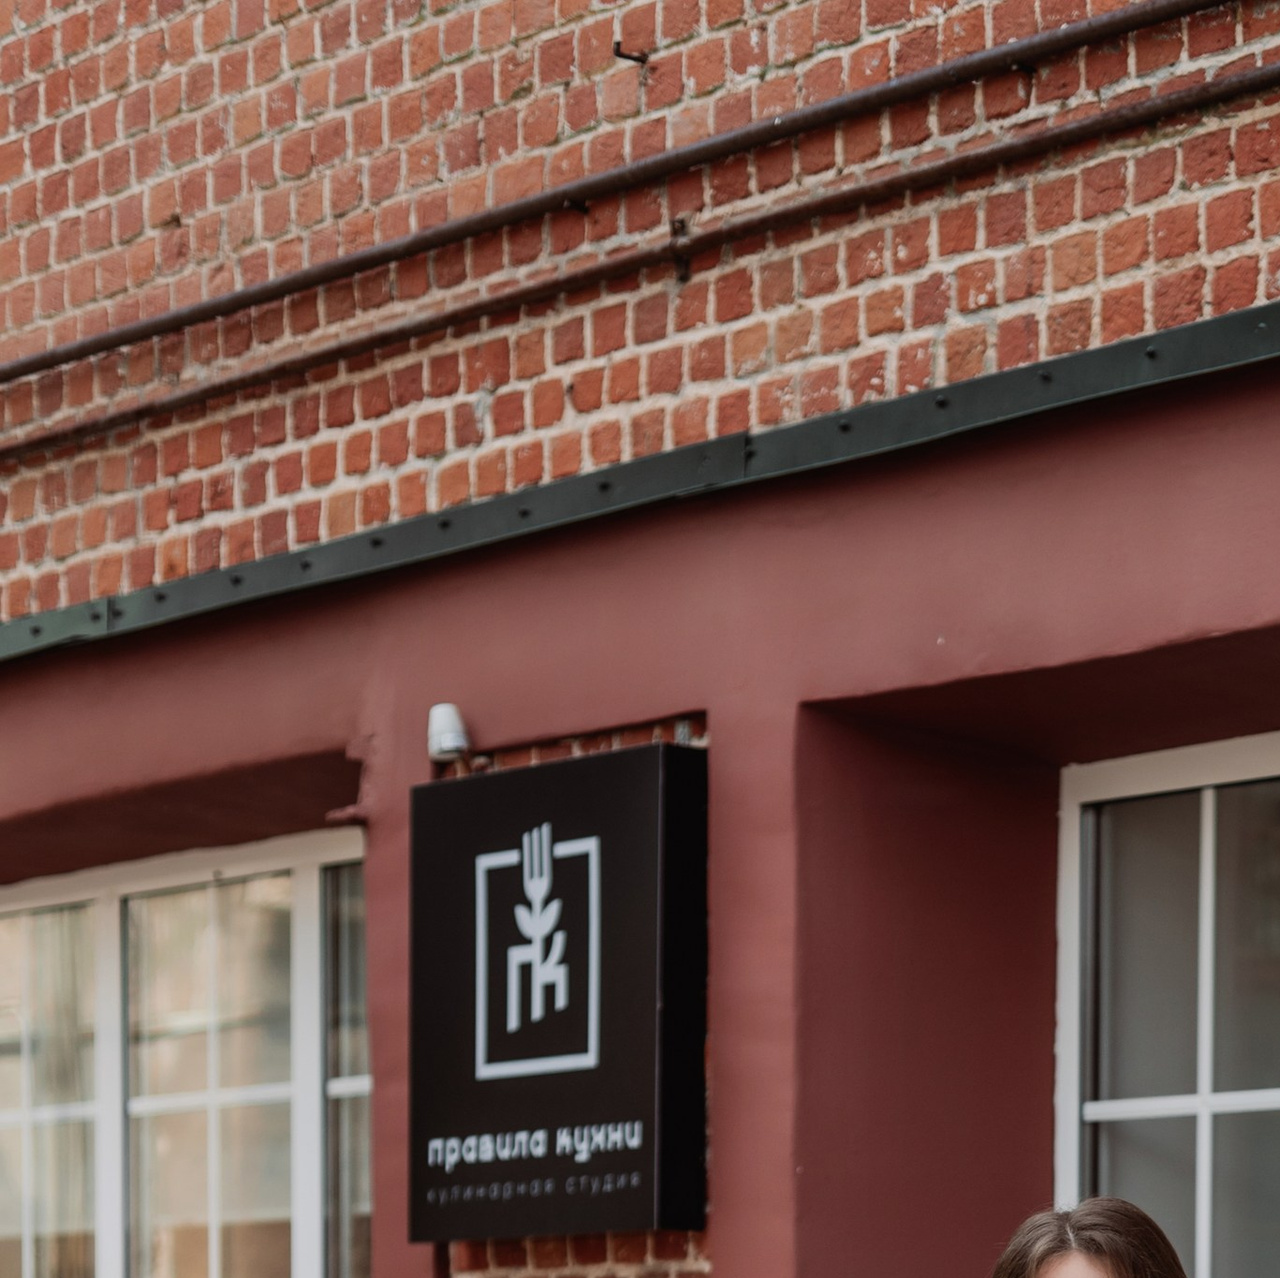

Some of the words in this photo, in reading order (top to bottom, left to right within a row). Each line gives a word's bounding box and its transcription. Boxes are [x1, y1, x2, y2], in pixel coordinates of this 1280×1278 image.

[427, 1129, 548, 1173] правила
[556, 1120, 643, 1163] кухни
[427, 1178, 555, 1206] кулинарная
[565, 1171, 641, 1196] студия
